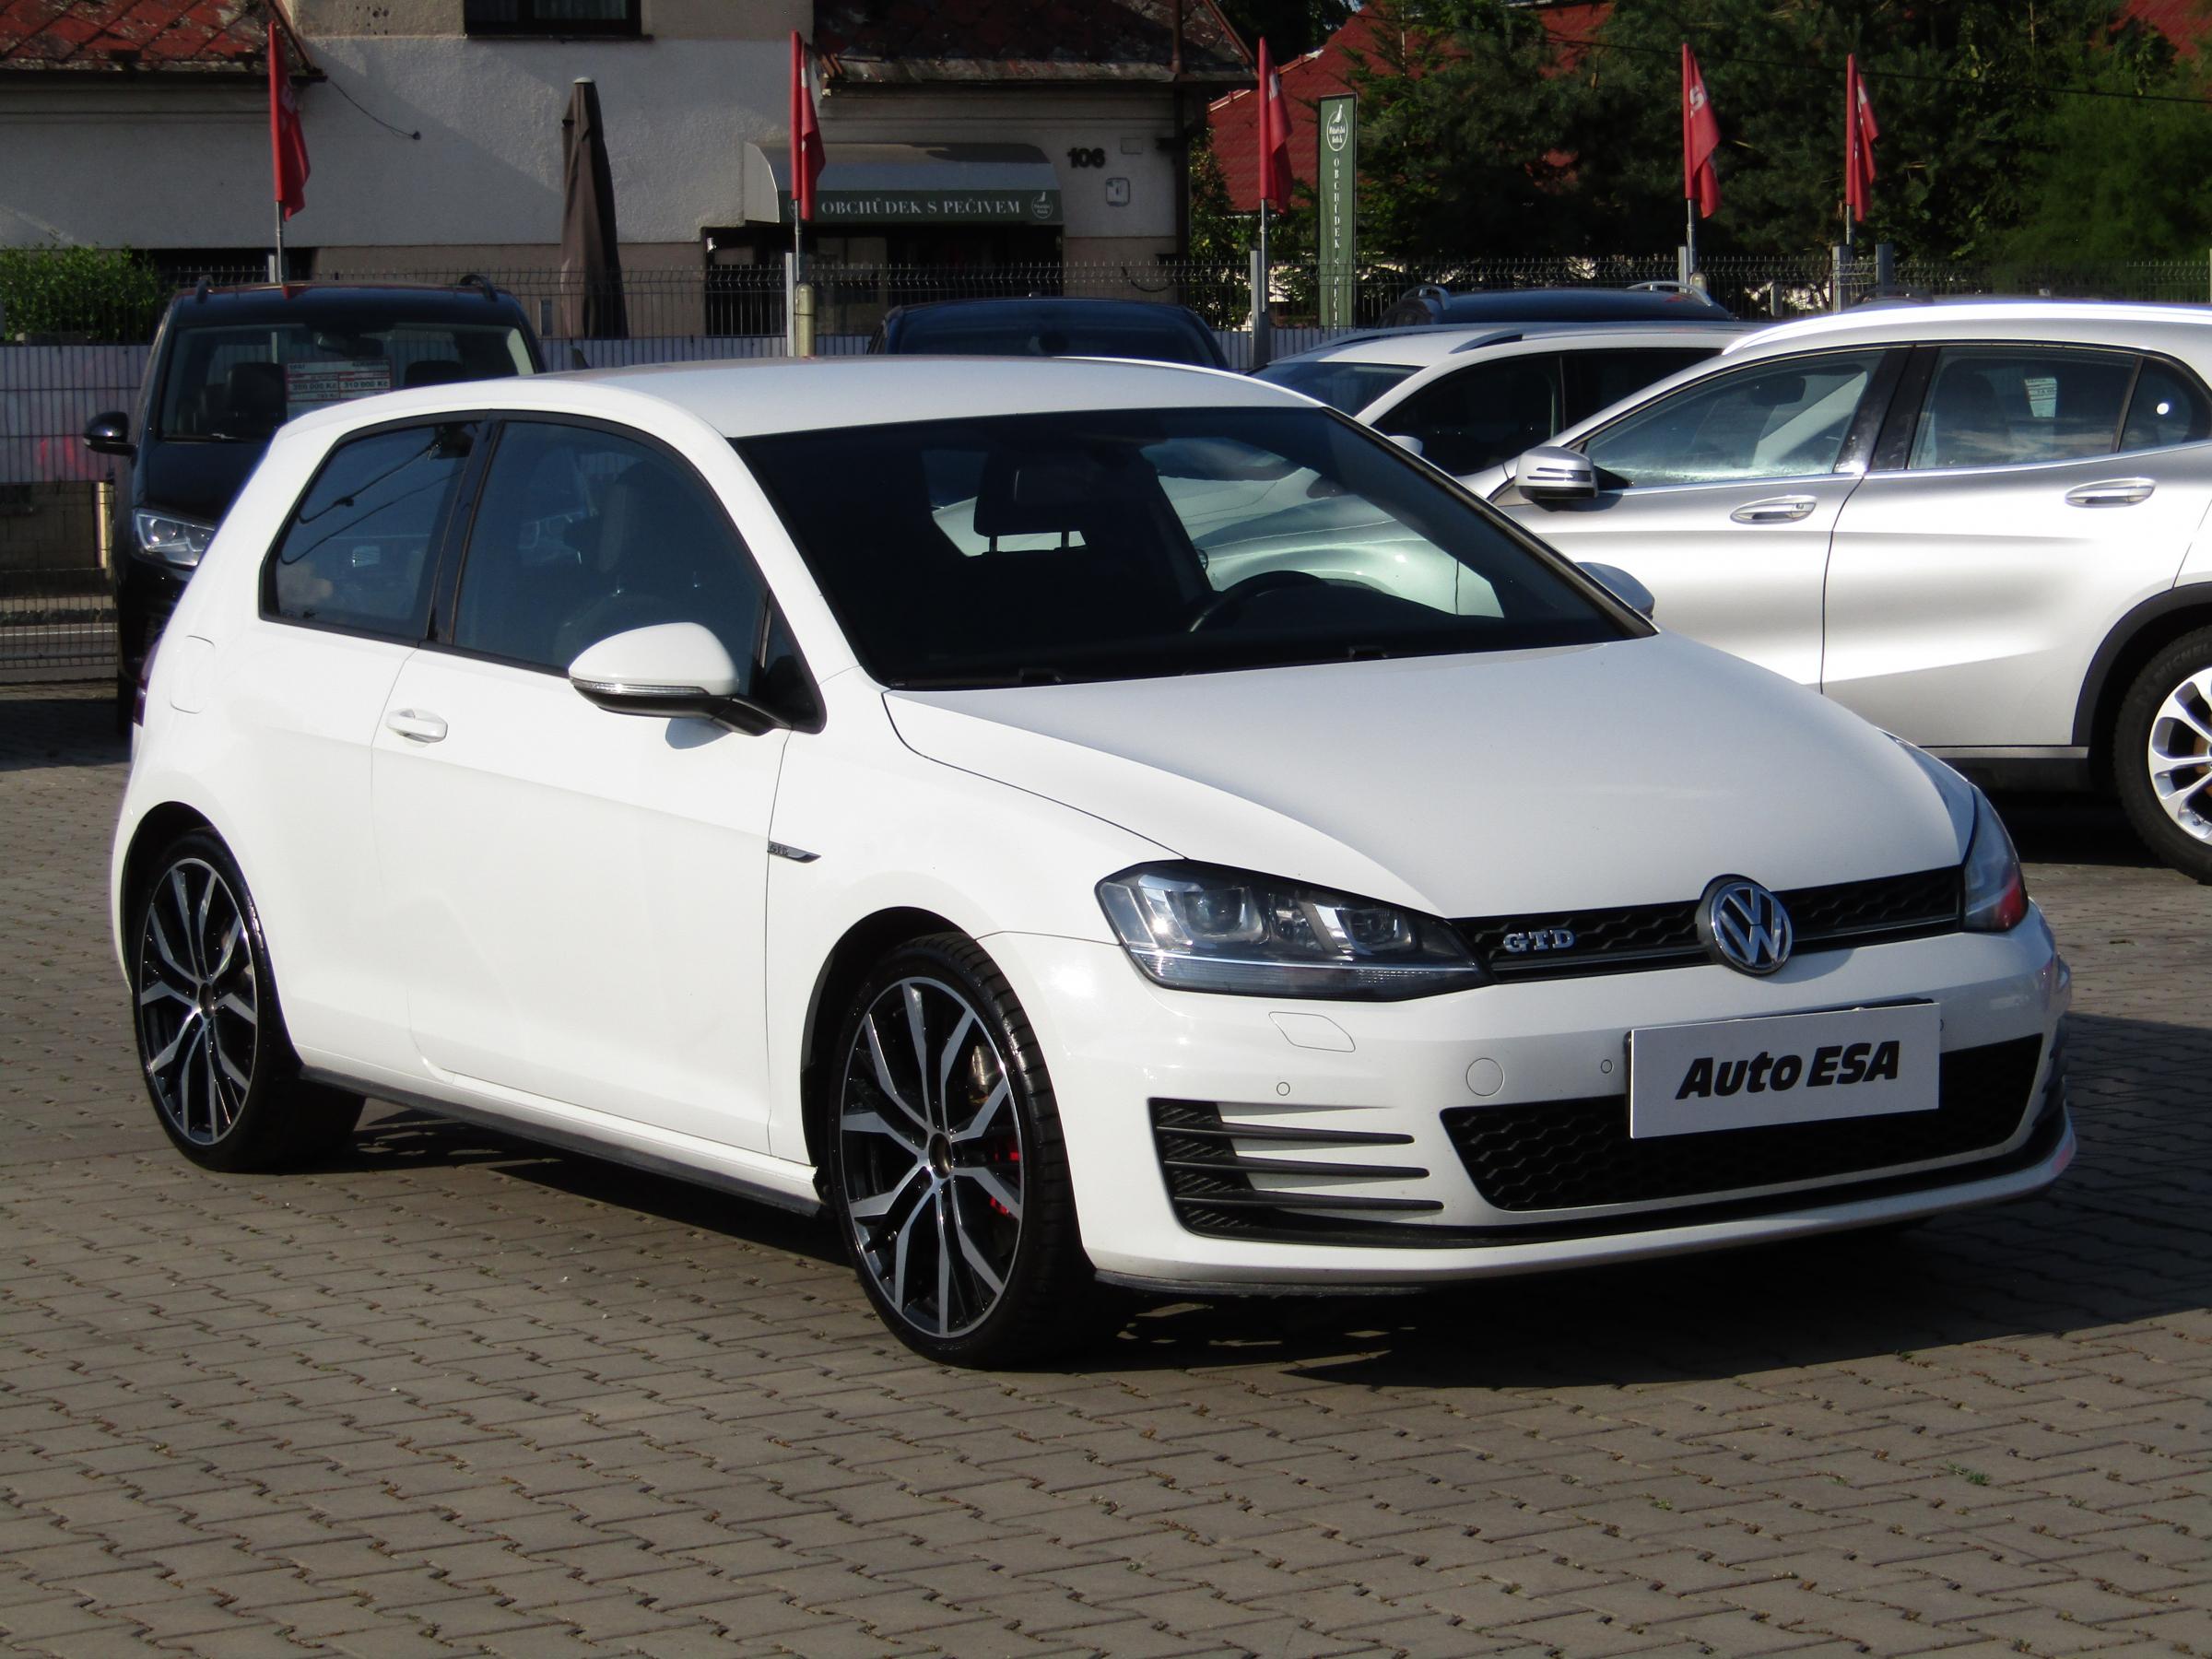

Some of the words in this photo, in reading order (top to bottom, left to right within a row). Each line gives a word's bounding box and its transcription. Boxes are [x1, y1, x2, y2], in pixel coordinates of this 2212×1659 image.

[1066, 147, 1106, 169] 106
[821, 197, 923, 214] OBCHŮDEK
[927, 200, 937, 214] S
[944, 197, 1019, 214] PEČIVEM
[1502, 929, 1575, 953] GTD
[1675, 1052, 1803, 1100] Auto
[1806, 1041, 1900, 1088] ESA
